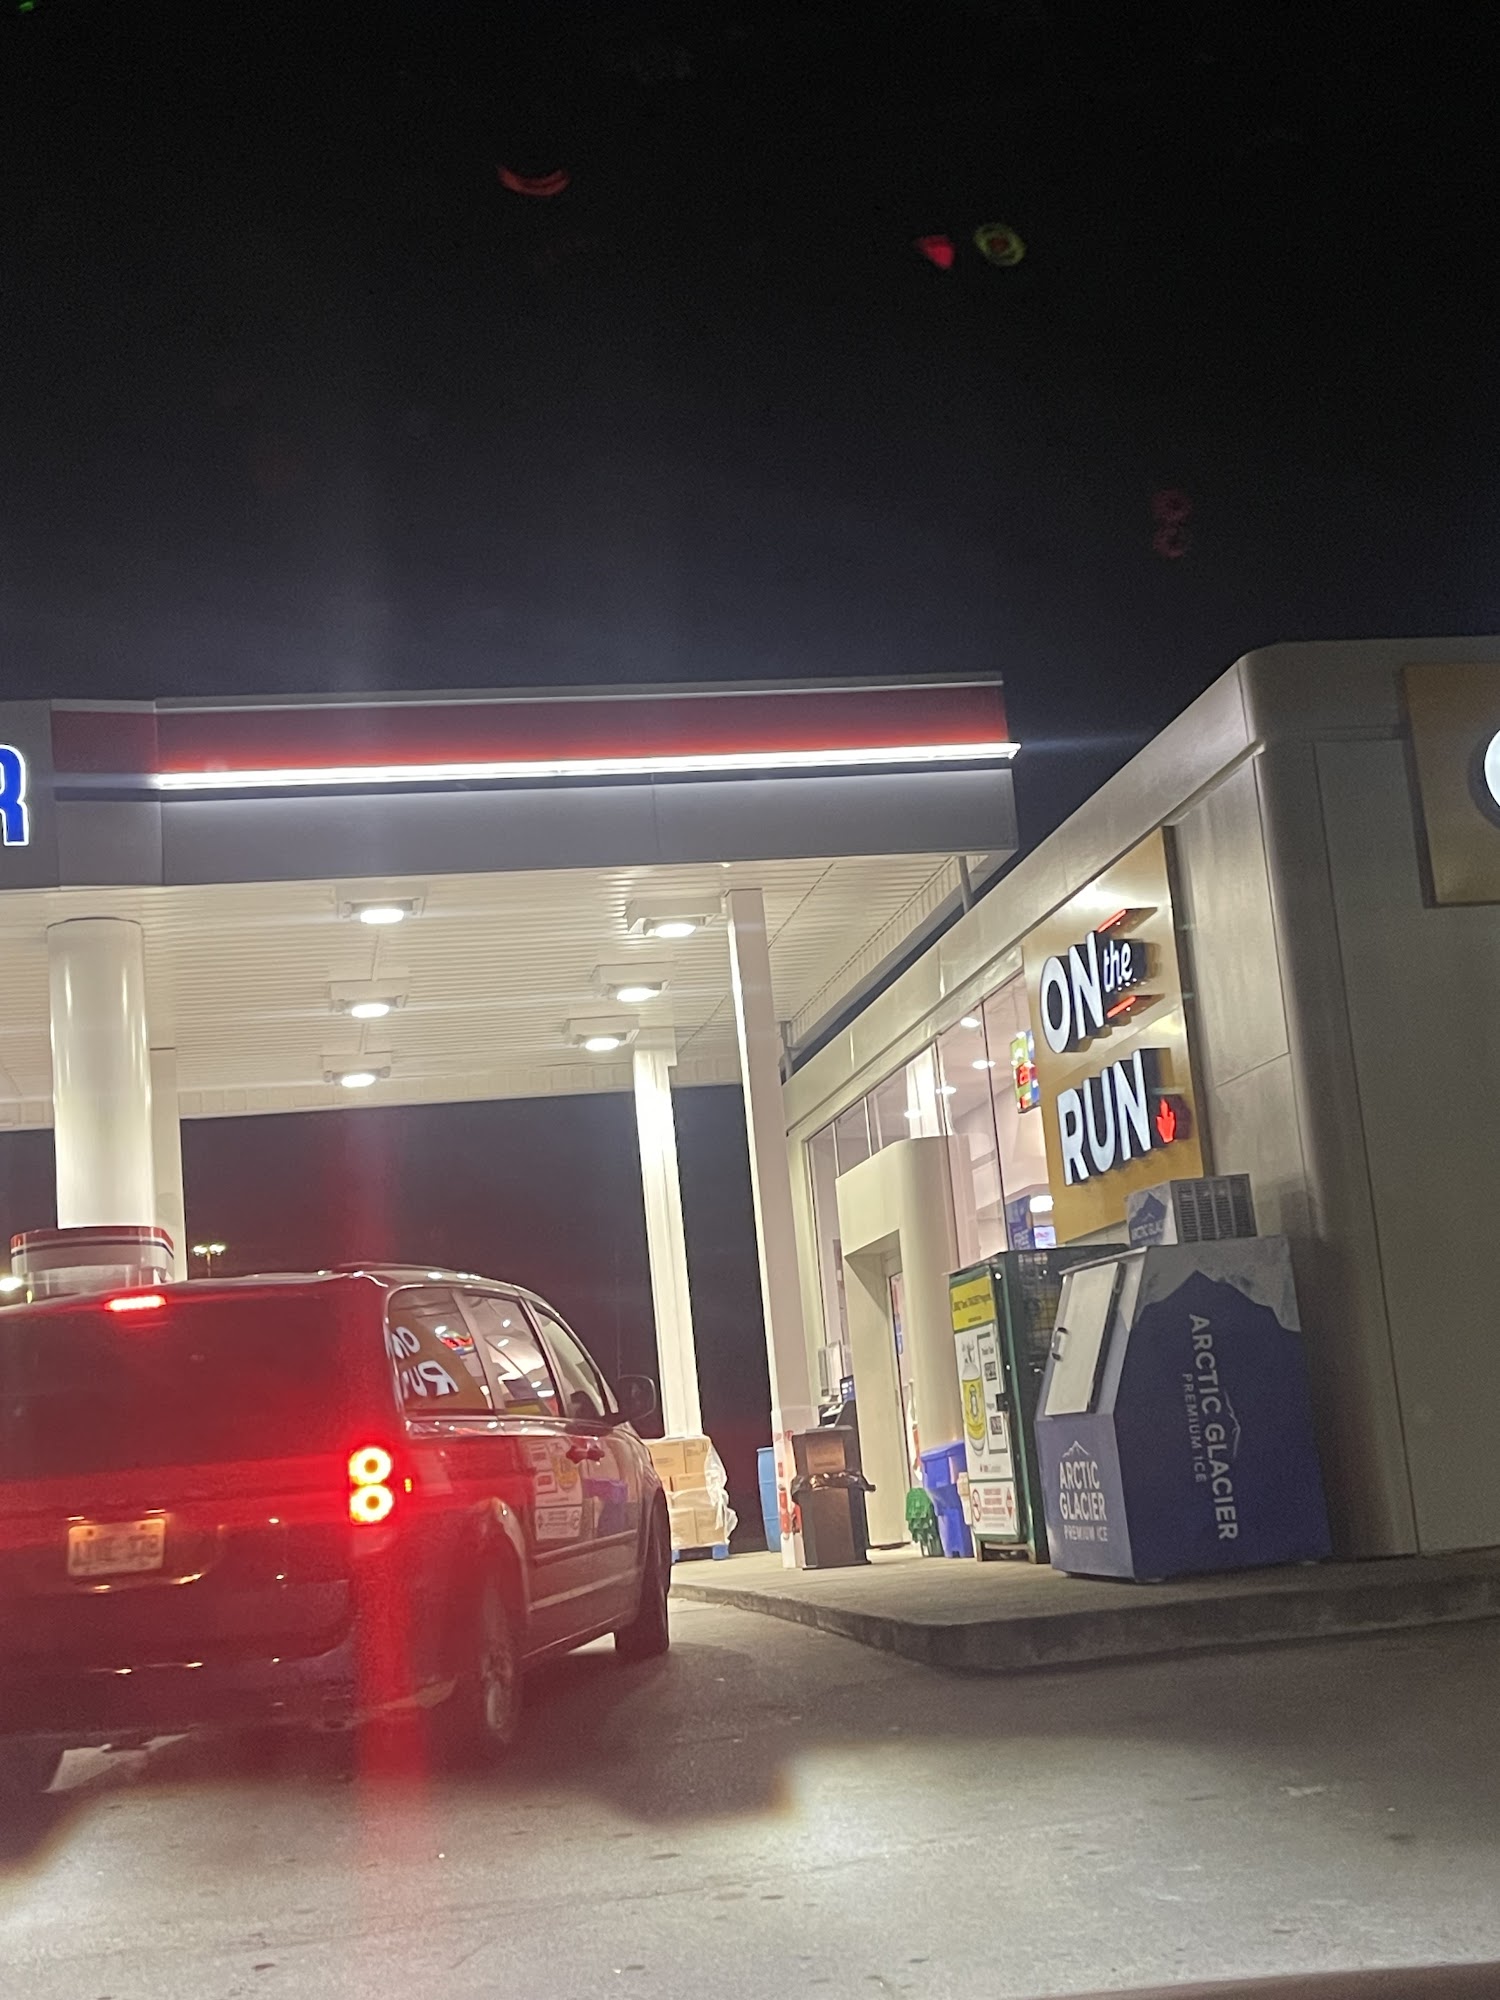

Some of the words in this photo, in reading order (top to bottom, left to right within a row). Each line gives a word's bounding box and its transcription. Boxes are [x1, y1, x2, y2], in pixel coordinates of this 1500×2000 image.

[1040, 930, 1104, 1054] ON
[1103, 940, 1133, 993] the
[1056, 1049, 1152, 1186] RUN
[1189, 1313, 1222, 1415] ARCTIC
[1060, 1461, 1100, 1490] ARCTIC
[1182, 1372, 1203, 1450] PREMIUM
[1193, 1455, 1208, 1484] ICE
[1205, 1423, 1239, 1541] GLACIER
[1060, 1492, 1107, 1521] GLACIER
